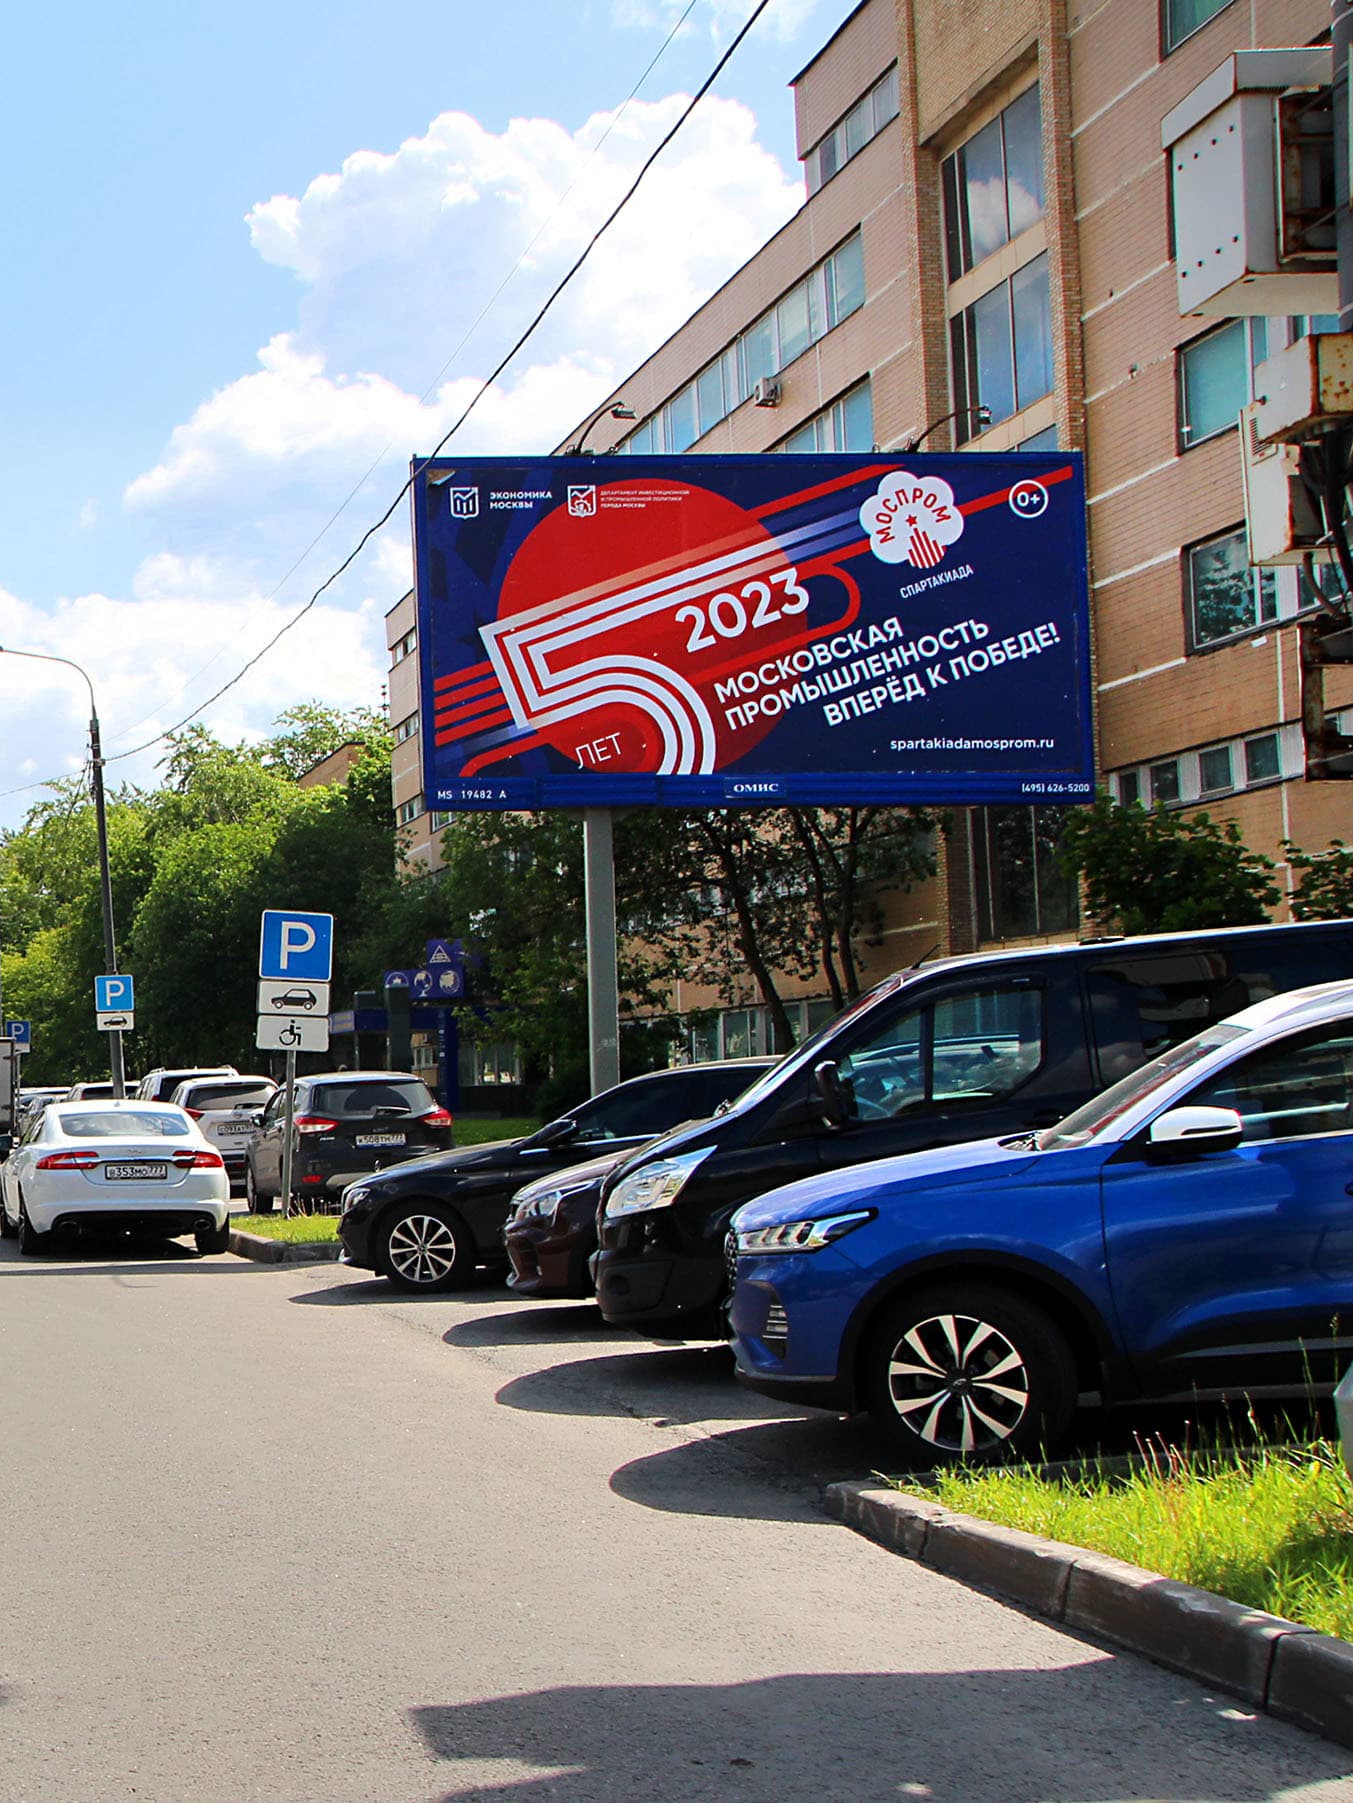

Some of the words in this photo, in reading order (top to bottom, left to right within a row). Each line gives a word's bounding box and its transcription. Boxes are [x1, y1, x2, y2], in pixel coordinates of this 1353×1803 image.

[489, 490, 552, 500] ЭКОНОМИКА
[489, 501, 533, 510] МОСКВЫ
[1016, 491, 1040, 507] 0+
[876, 487, 951, 543] МОСПРОМ
[900, 564, 974, 599] СПАРТАКИАДА
[675, 567, 810, 653] 2023
[713, 616, 904, 704] МОСКОВСКАЯ
[724, 619, 989, 731] ПРОМЫШЛЕННОСТЬ
[823, 675, 926, 727] ВПЕРЁД
[929, 669, 948, 690] К
[949, 622, 1061, 682] ПОБЕДЕ!
[575, 732, 621, 770] ЛЕТ
[890, 736, 1054, 751] spartakiadamosprom.ru
[437, 790, 453, 799] MS
[461, 790, 493, 799] 19482
[499, 790, 507, 799] A
[733, 783, 779, 793] ОМИС
[1021, 783, 1045, 793] (495)
[1047, 783, 1090, 793] 626-5200
[279, 921, 316, 970] P
[106, 980, 125, 1006] P
